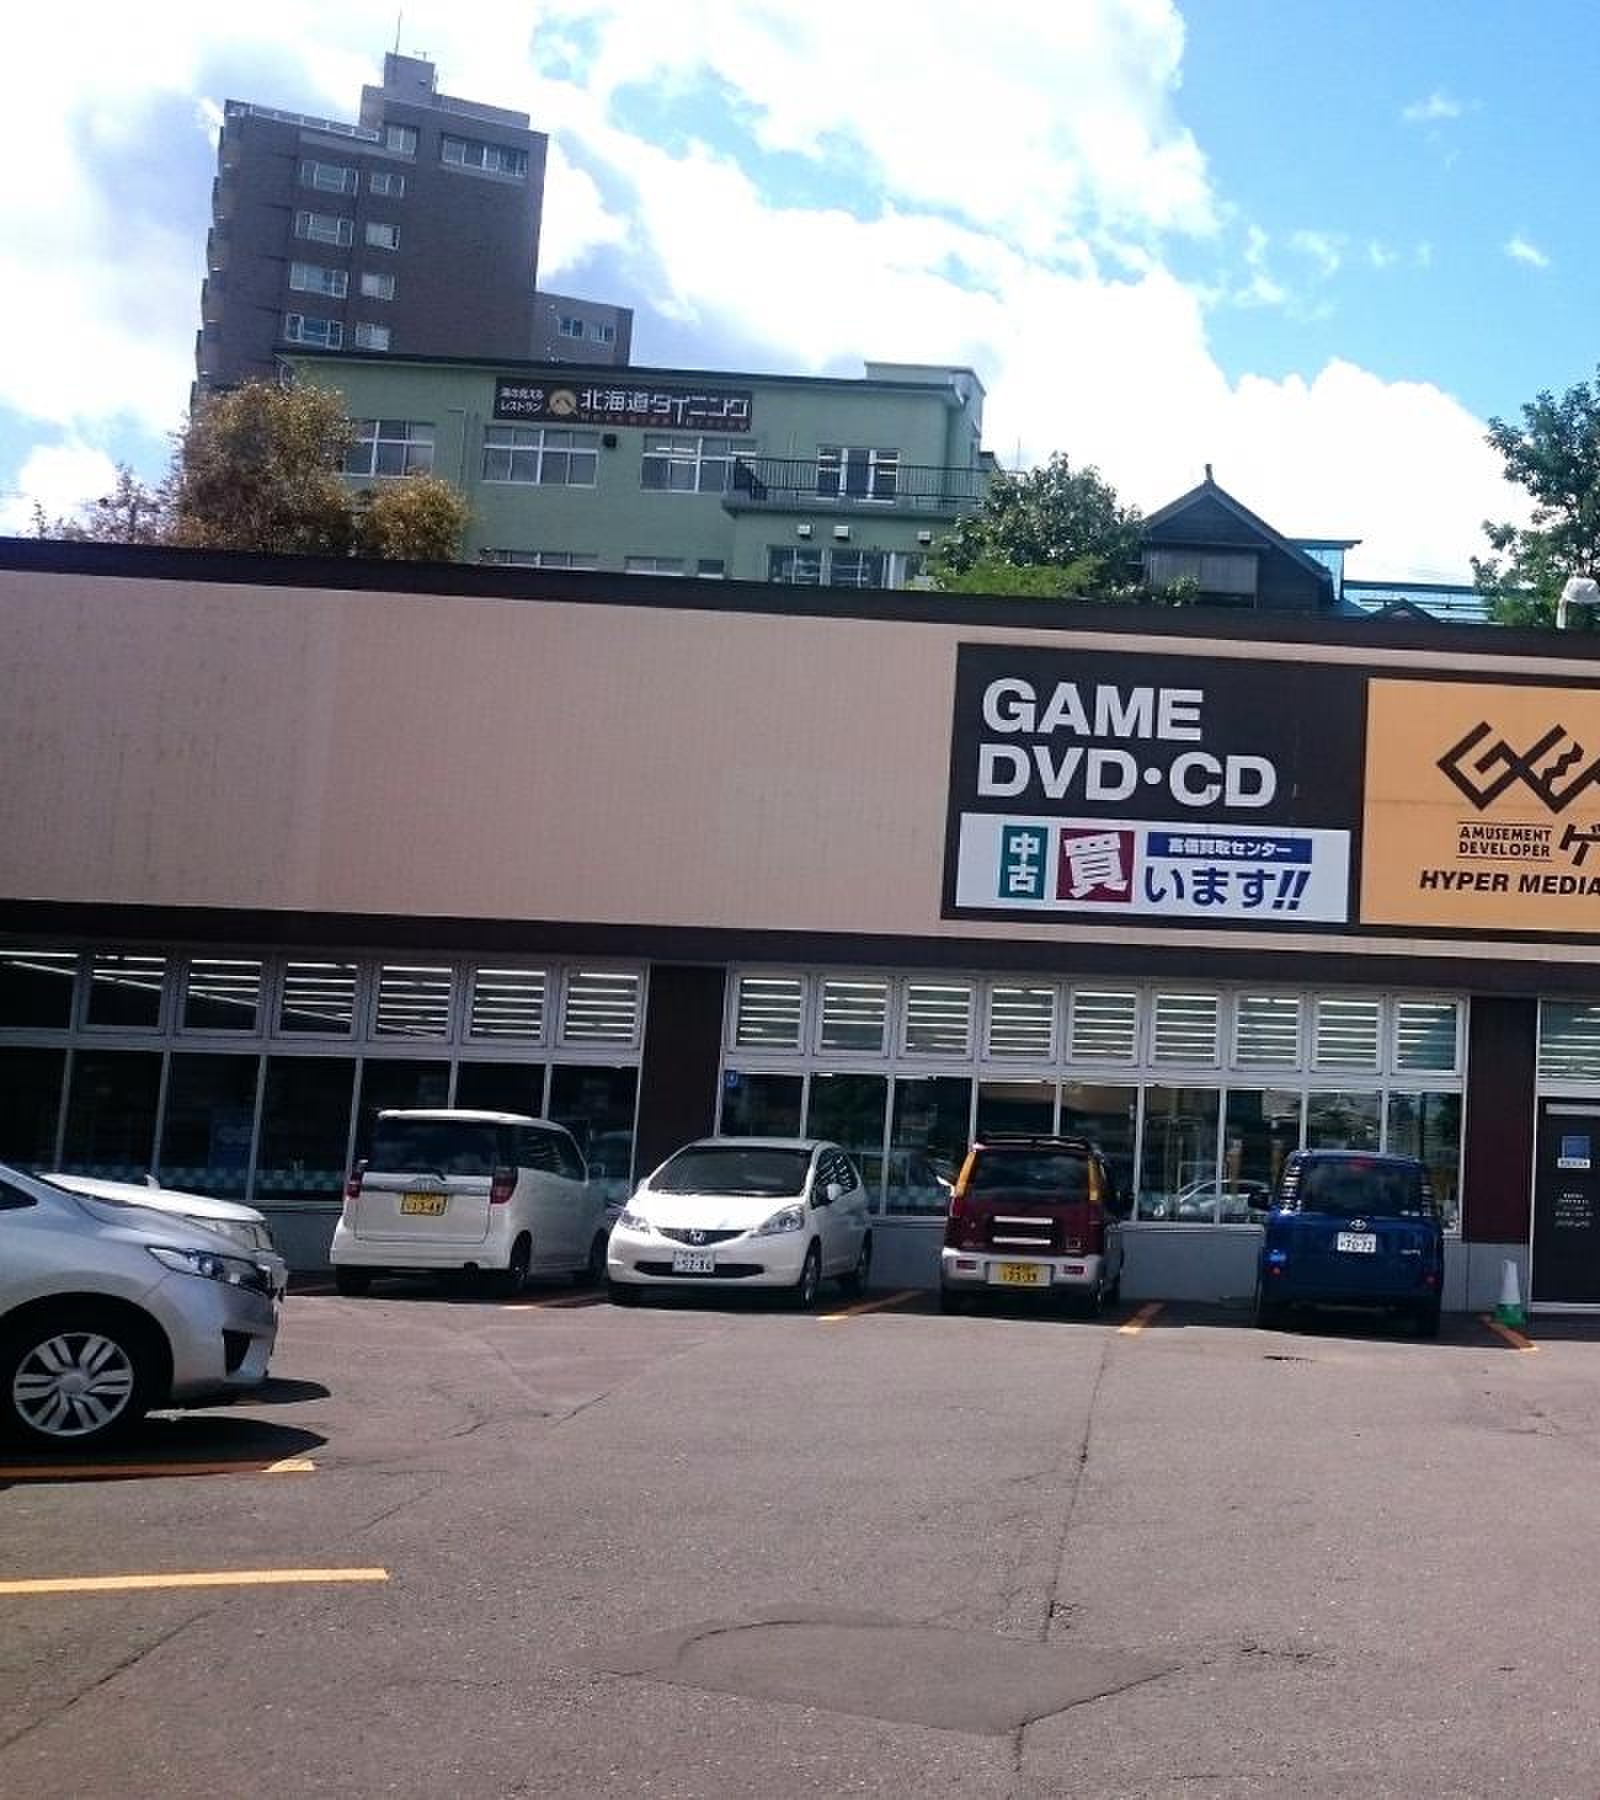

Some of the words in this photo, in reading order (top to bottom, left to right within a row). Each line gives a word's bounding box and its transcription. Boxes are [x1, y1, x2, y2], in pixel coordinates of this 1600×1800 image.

[981, 677, 1204, 742] GAME
[1459, 826, 1551, 842] AMUSEMENT
[1459, 840, 1550, 857] DEVELOPER
[1008, 832, 1041, 893] 中古
[1420, 870, 1510, 892] HYPER
